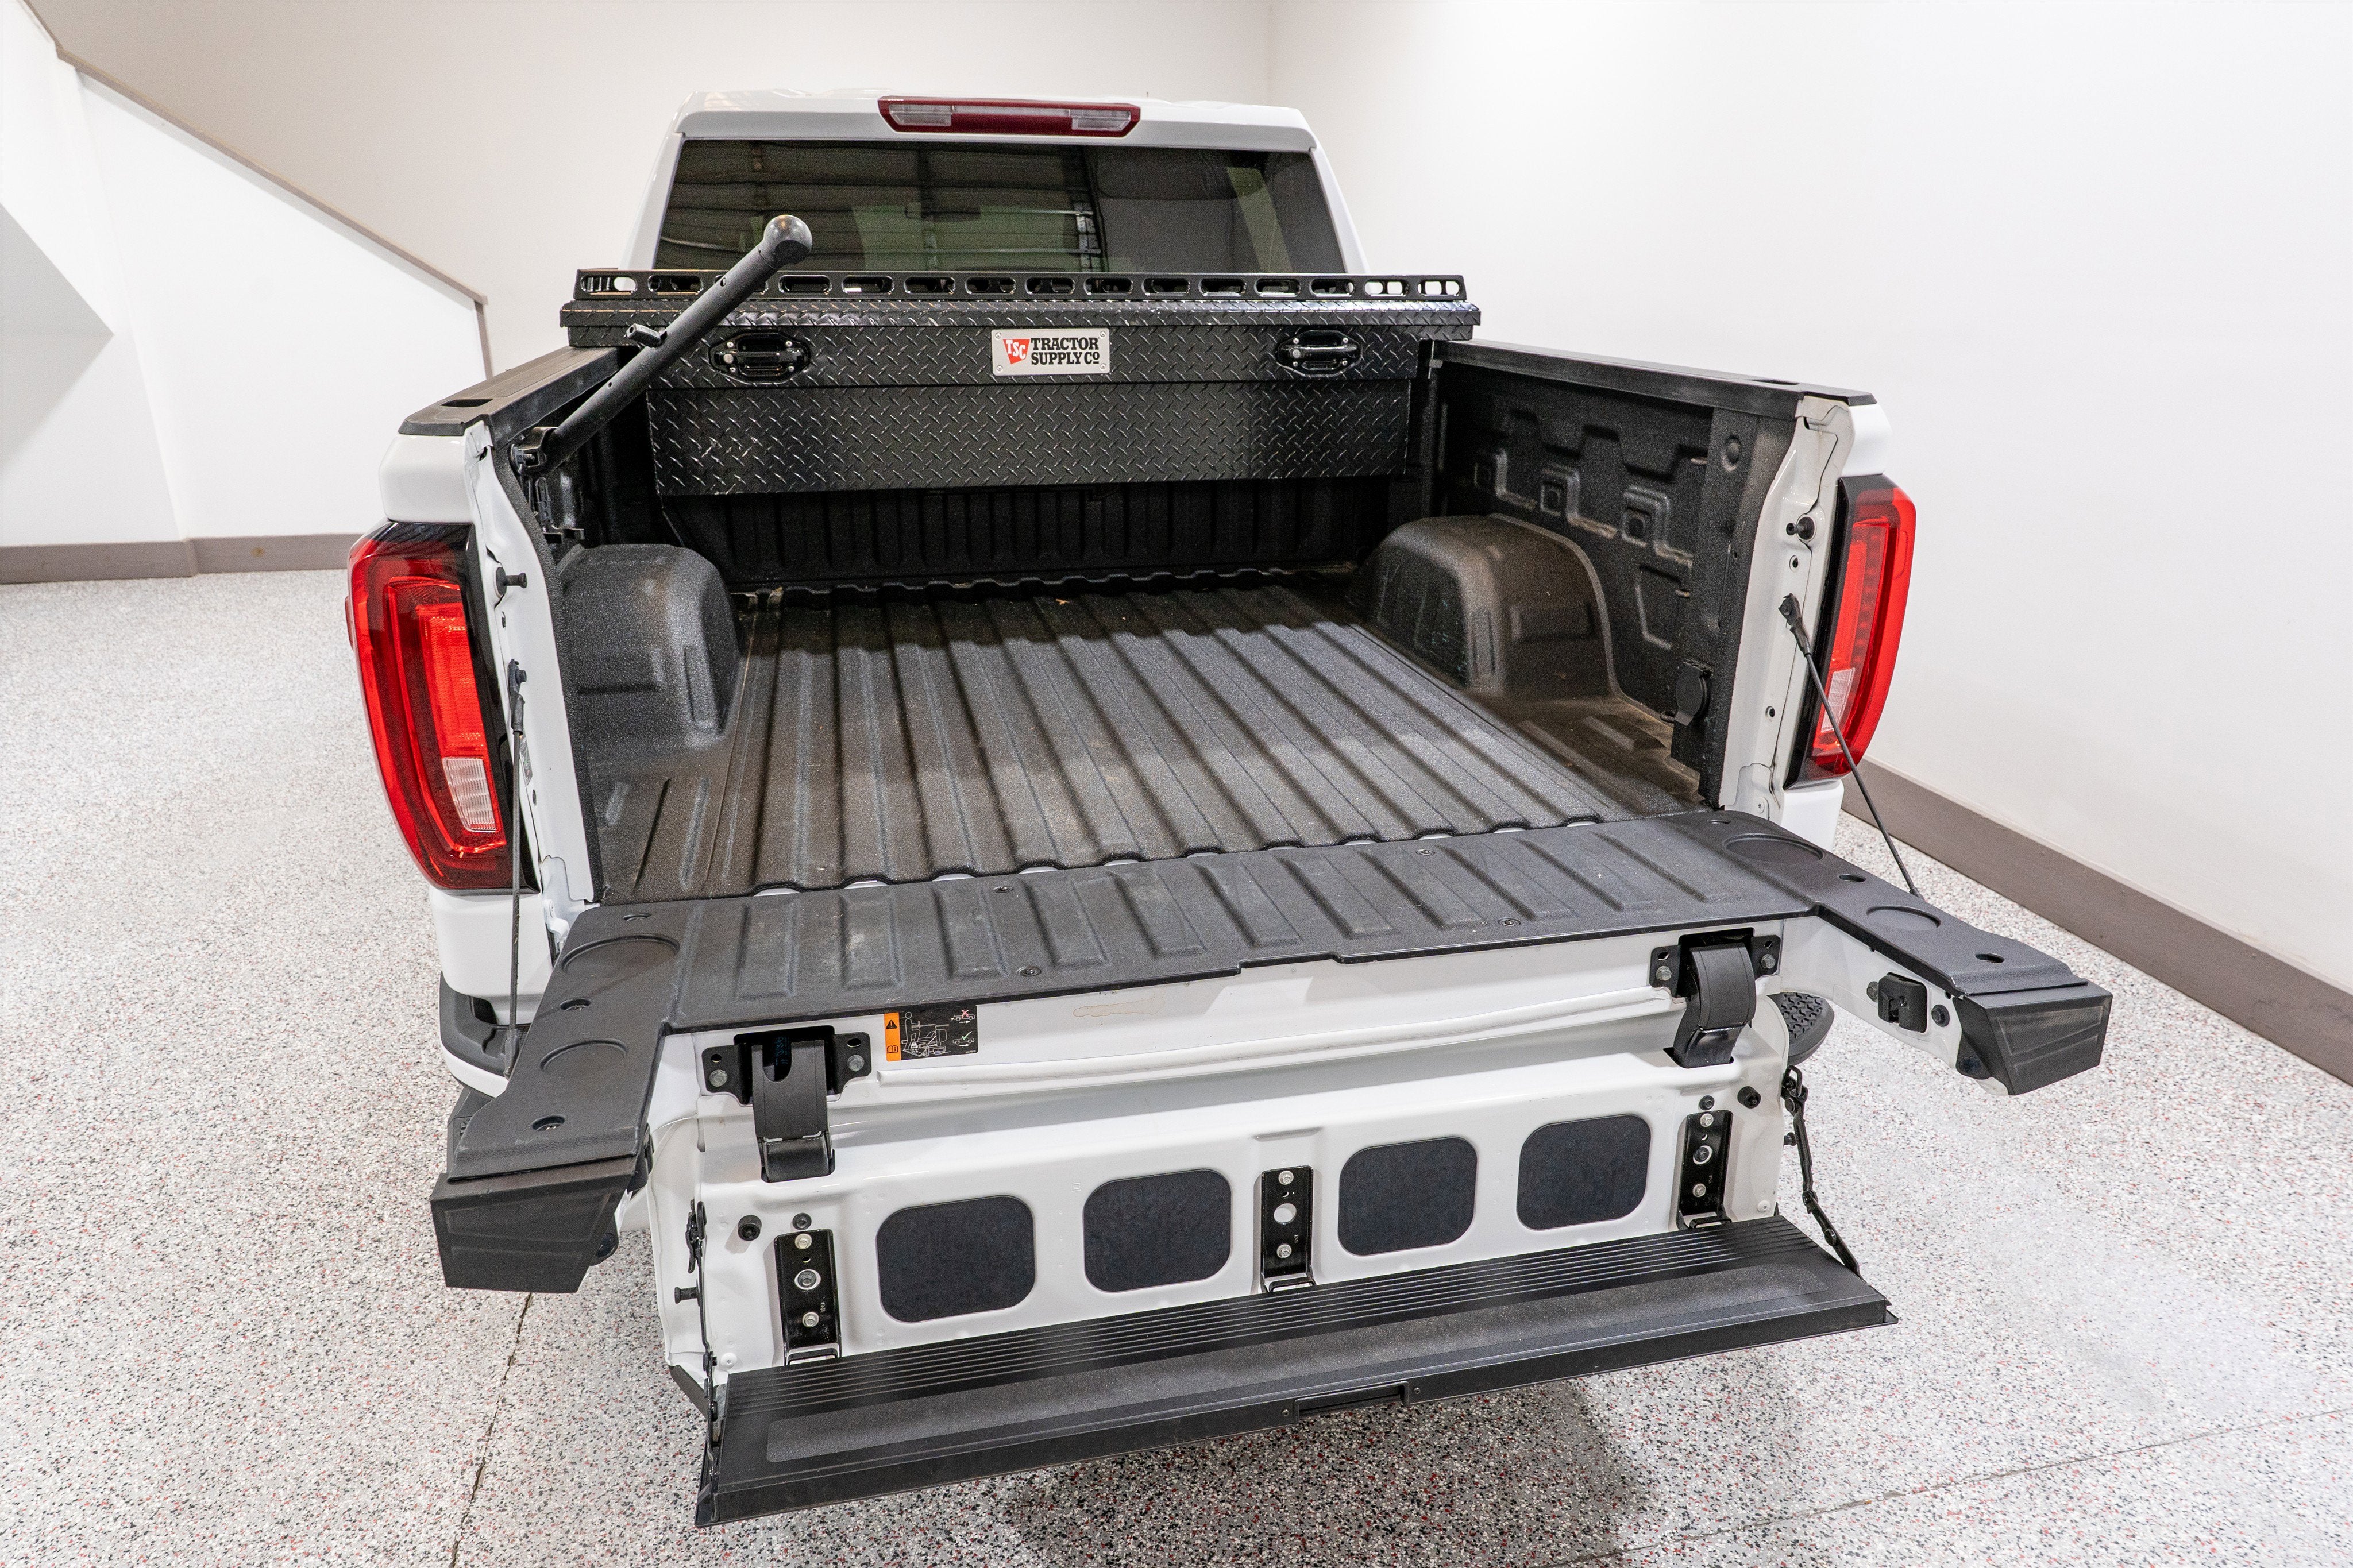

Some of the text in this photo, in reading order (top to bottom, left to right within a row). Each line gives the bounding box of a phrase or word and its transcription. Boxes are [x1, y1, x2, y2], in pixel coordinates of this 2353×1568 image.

[1006, 339, 1026, 360] TSC
[1031, 337, 1099, 350] TRACTOR
[1031, 352, 1082, 365] SUPPLY
